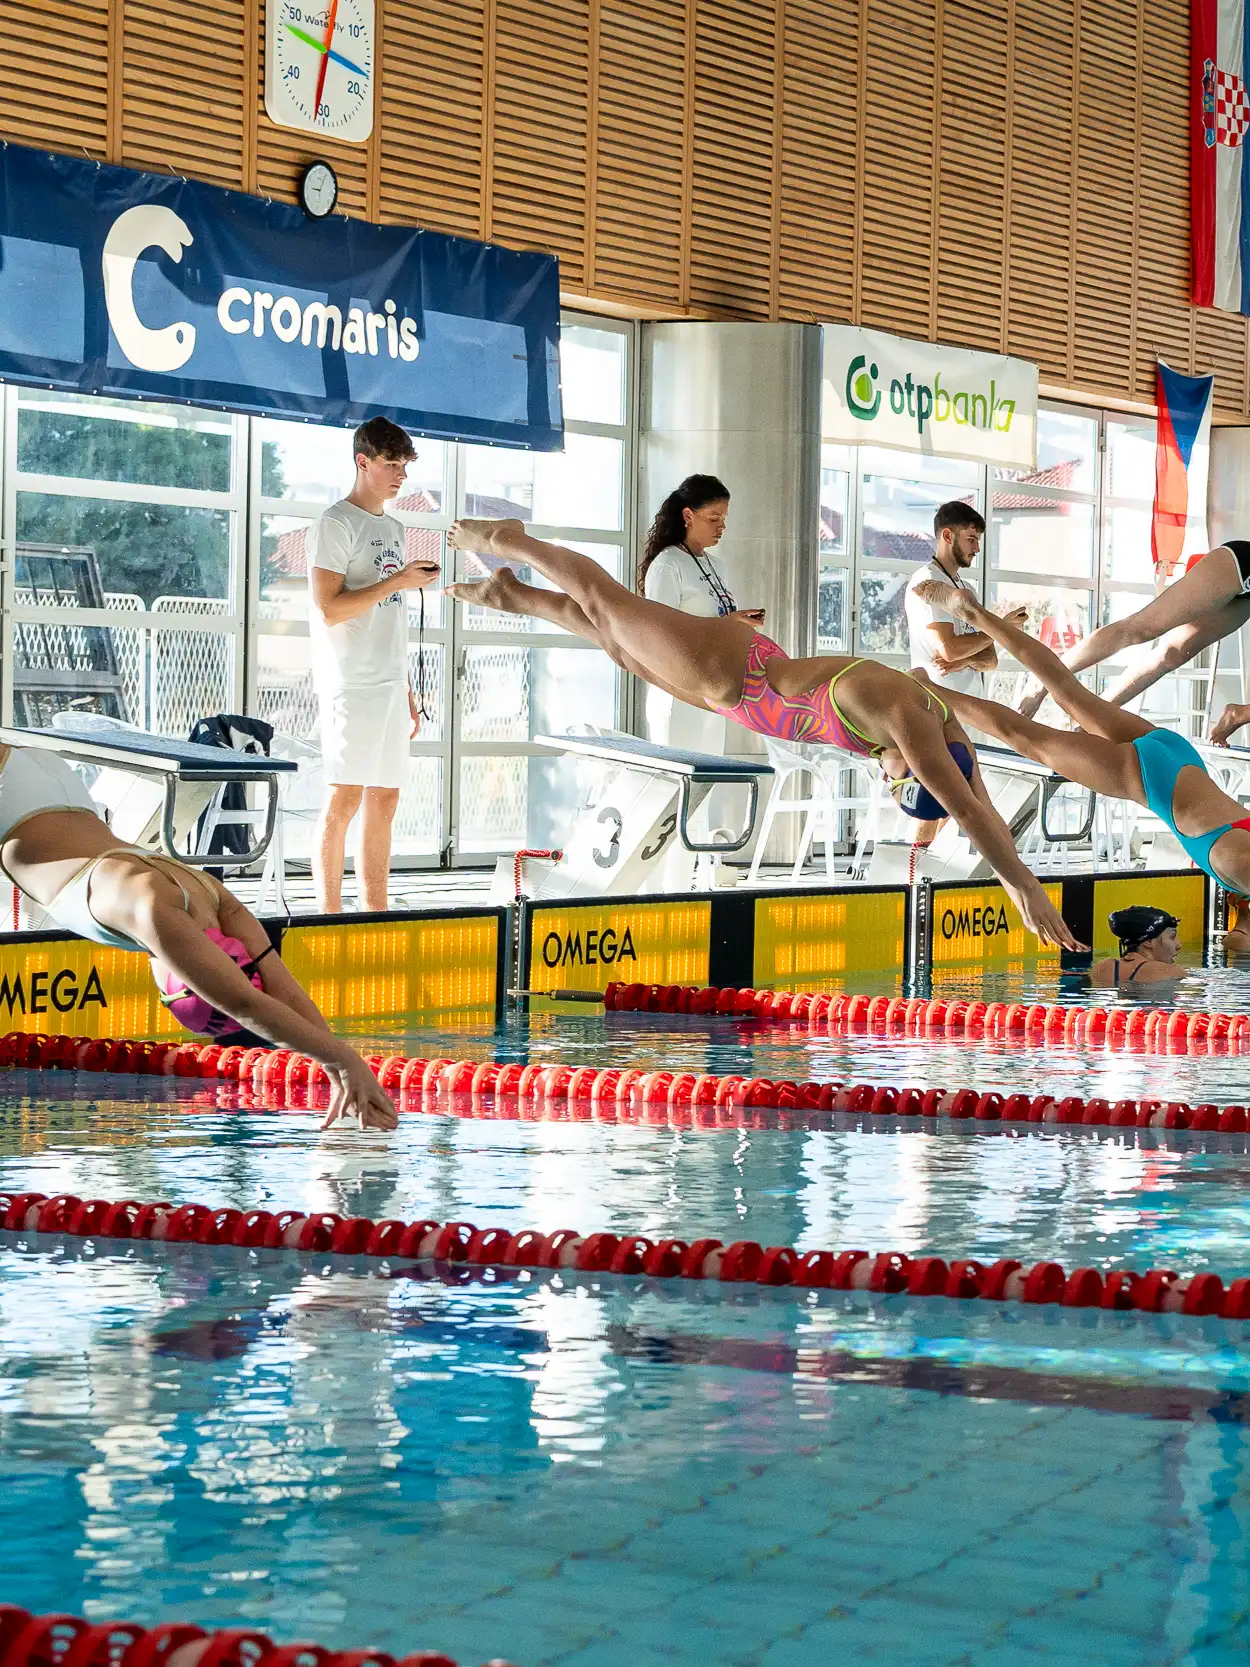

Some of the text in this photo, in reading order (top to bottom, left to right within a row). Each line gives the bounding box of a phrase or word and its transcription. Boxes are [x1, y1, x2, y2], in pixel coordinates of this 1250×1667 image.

[289, 7, 301, 21] 50
[304, 14, 344, 33] Watefly
[348, 24, 360, 38] 10
[287, 65, 300, 79] 40
[347, 81, 360, 95] 20
[317, 104, 330, 118] 30
[217, 286, 420, 361] cromaris
[592, 806, 623, 868] 3
[641, 812, 677, 861] 3
[941, 903, 1009, 940] OMEGA
[542, 925, 637, 968] OMEGA
